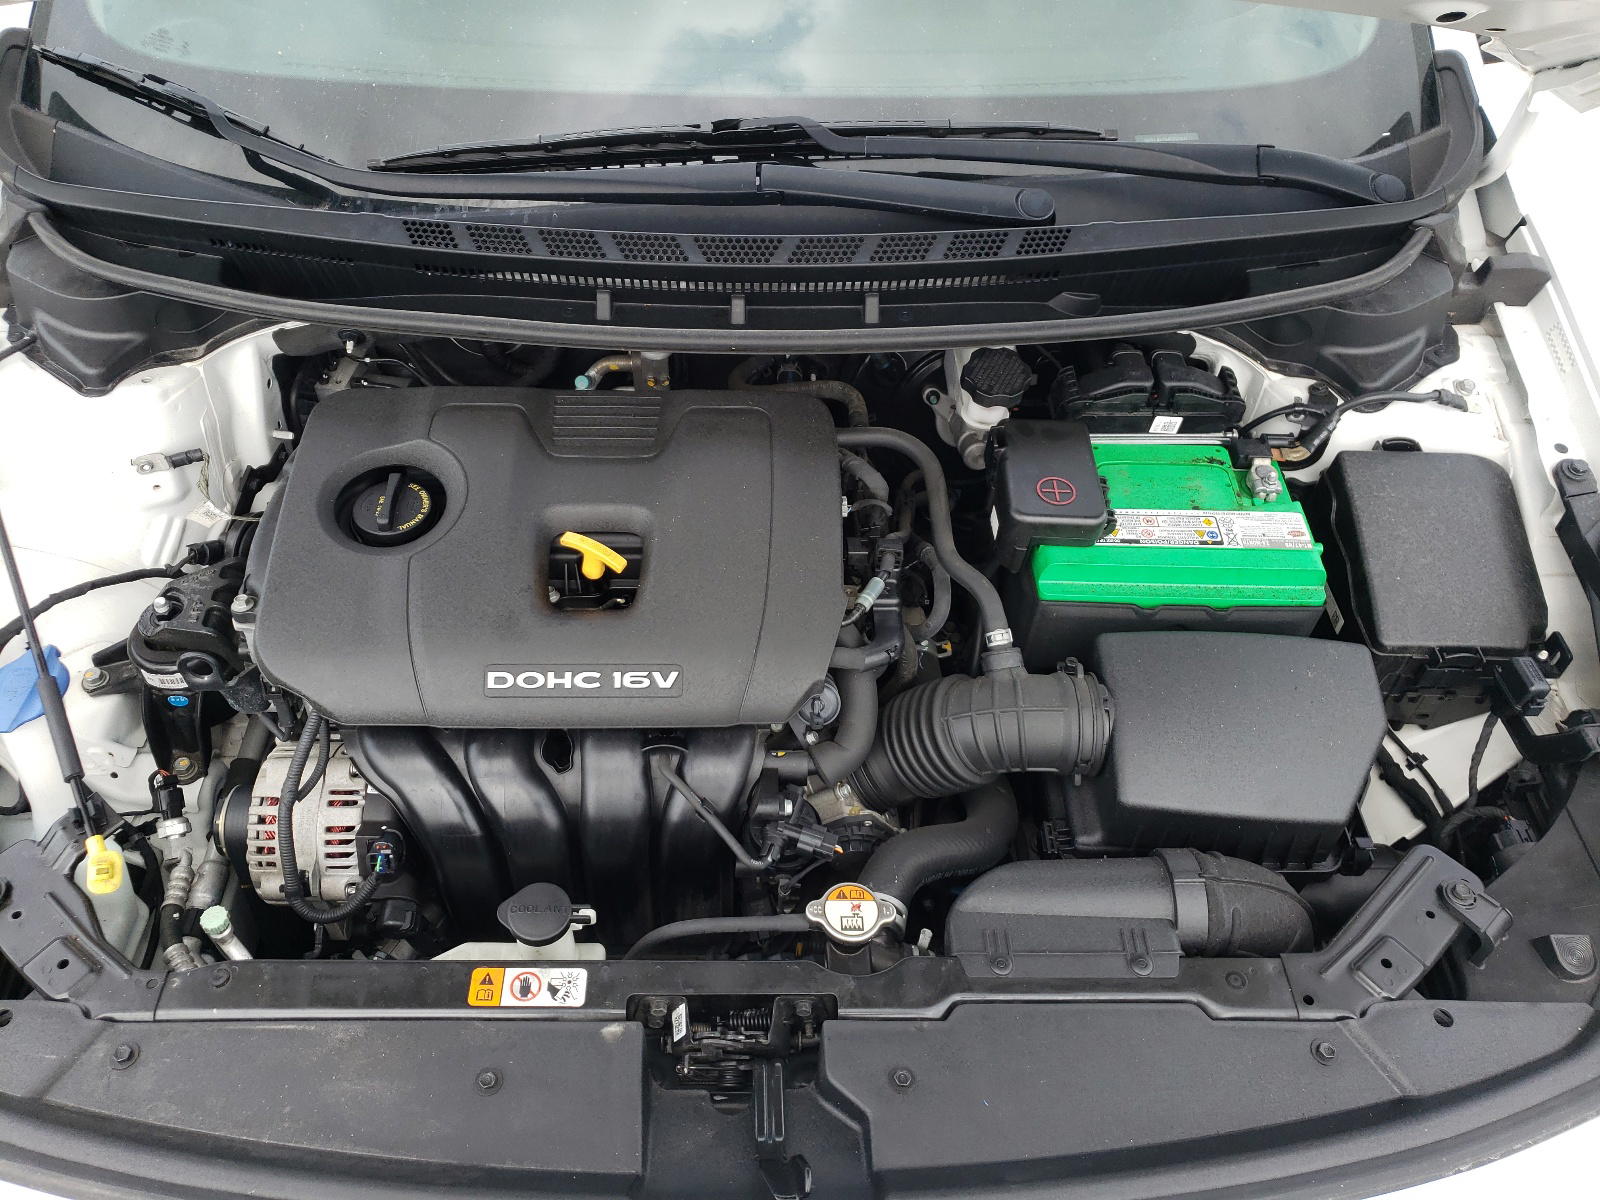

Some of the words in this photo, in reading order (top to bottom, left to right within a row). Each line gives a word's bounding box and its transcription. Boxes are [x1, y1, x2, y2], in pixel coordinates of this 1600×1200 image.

[408, 483, 421, 491] SEE
[397, 513, 424, 530] MANUAL
[487, 671, 601, 689] DOHC
[612, 671, 679, 689] 16V
[510, 903, 569, 914] COOLANT
